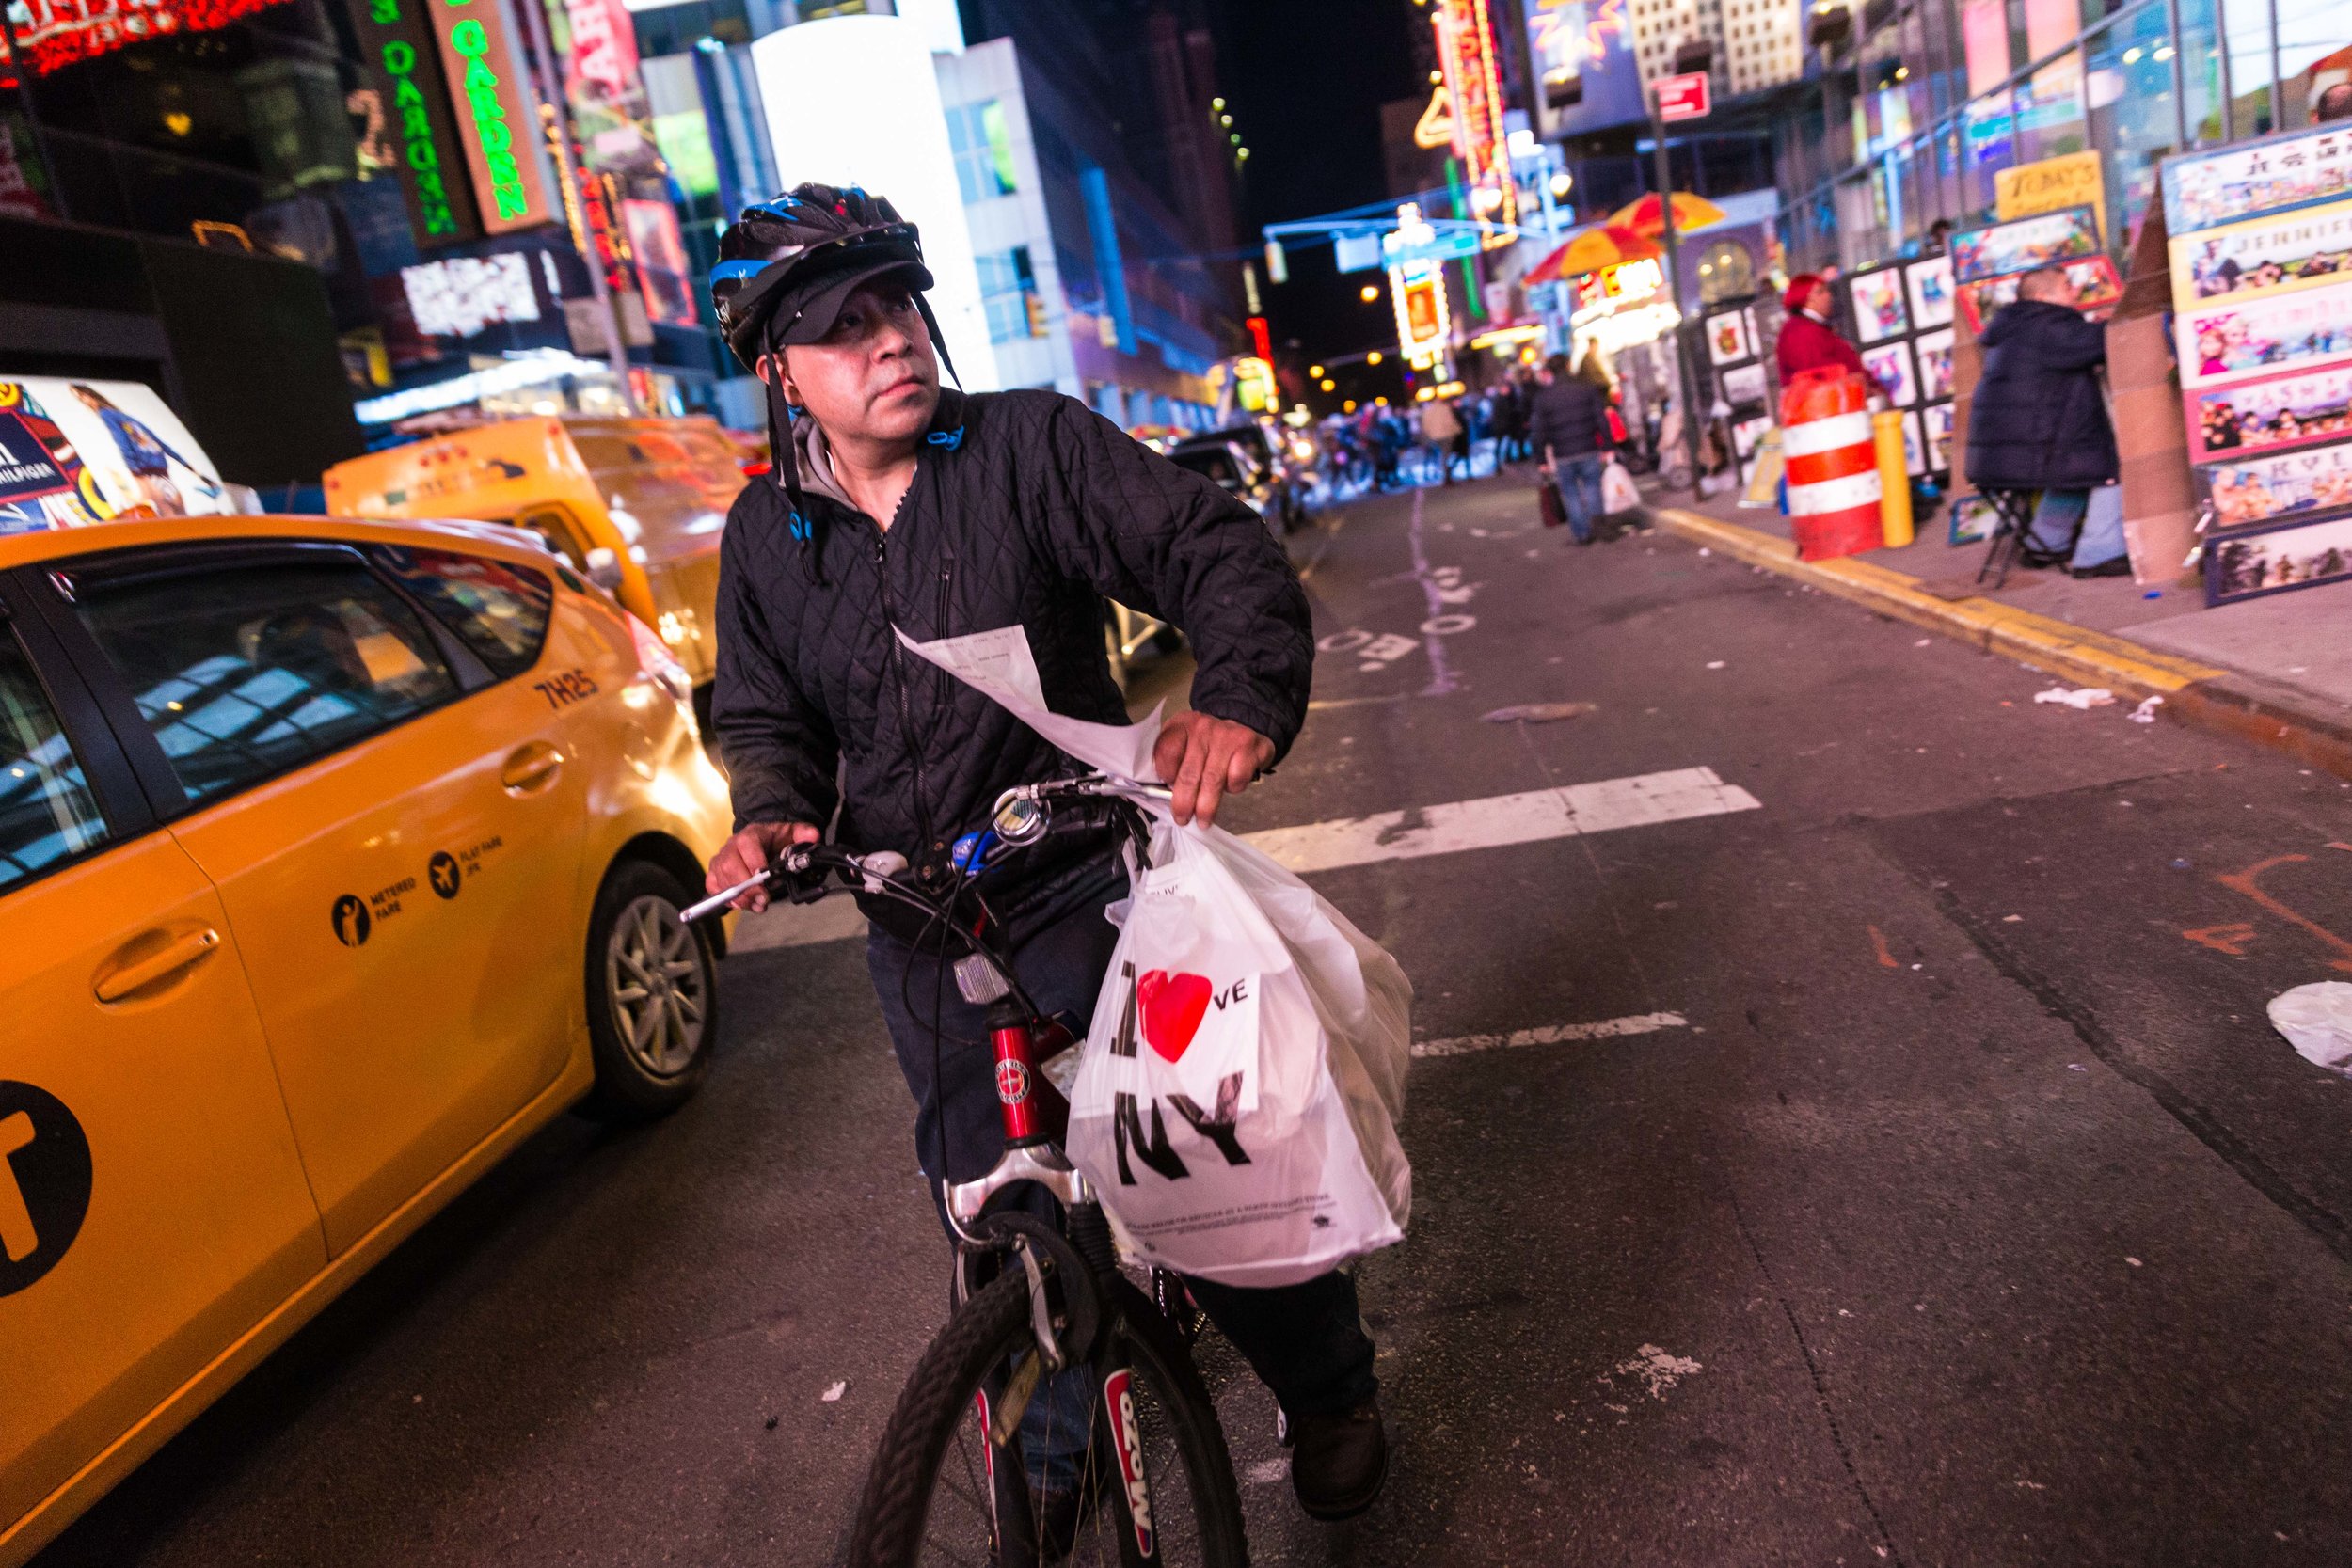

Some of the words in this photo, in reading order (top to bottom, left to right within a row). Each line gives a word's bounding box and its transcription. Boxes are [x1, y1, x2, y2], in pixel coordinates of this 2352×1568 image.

[533, 669, 599, 710] 7H25
[370, 876, 417, 907] METERED
[375, 899, 402, 922] FARE
[1110, 960, 1137, 1059] I
[1114, 1070, 1251, 1186] NY
